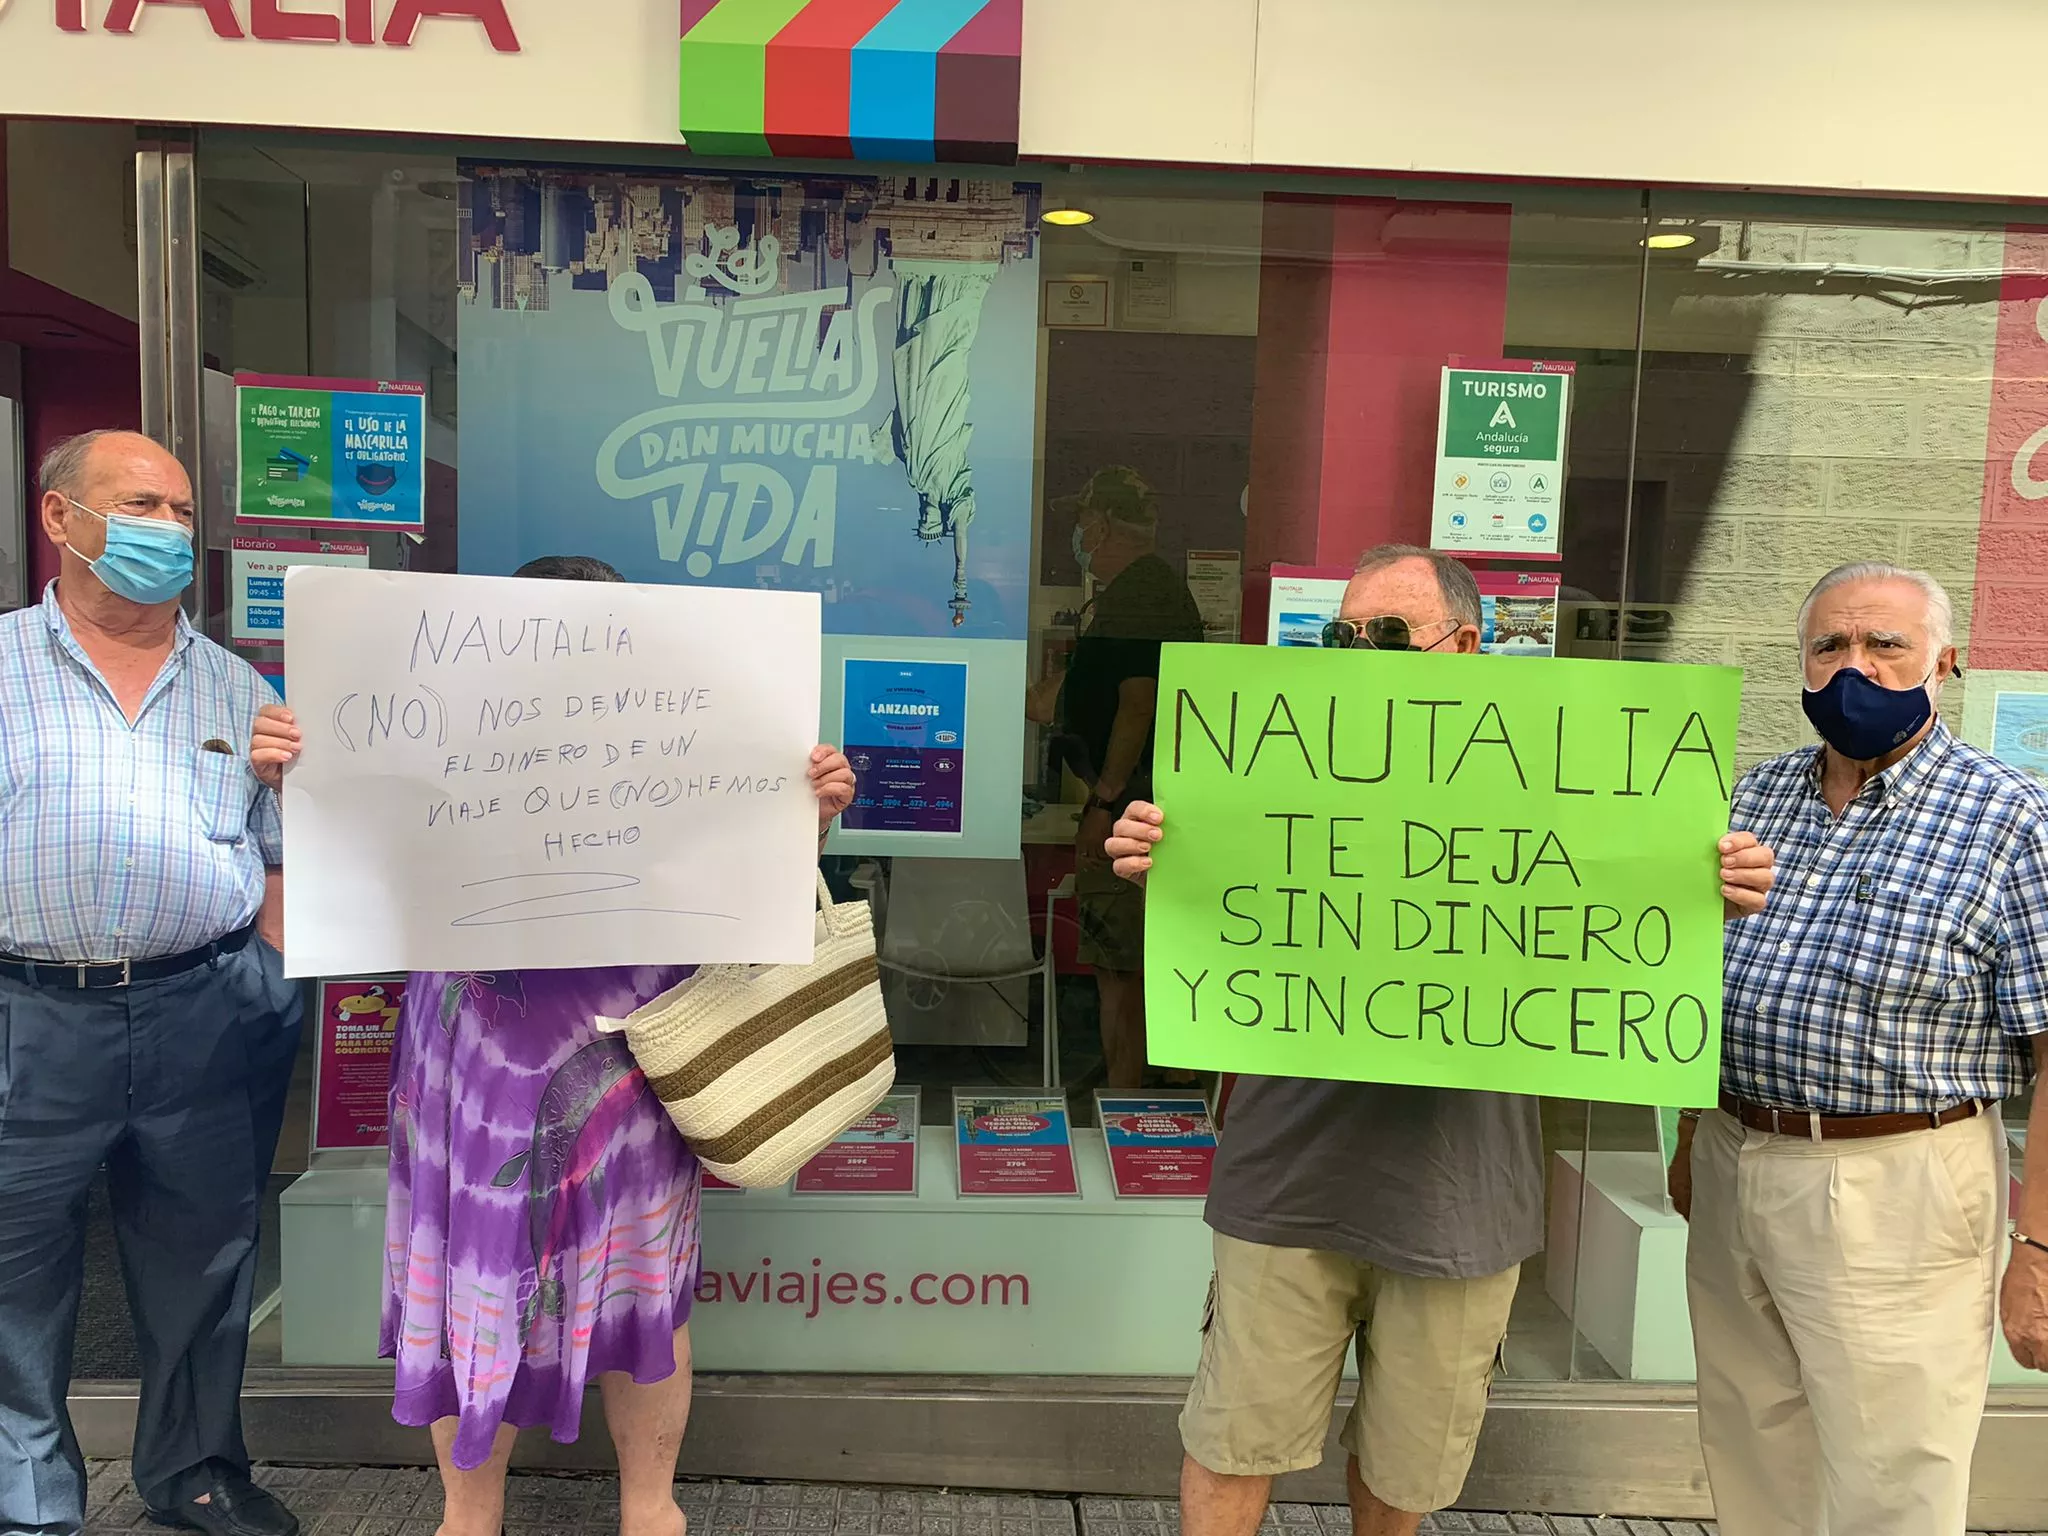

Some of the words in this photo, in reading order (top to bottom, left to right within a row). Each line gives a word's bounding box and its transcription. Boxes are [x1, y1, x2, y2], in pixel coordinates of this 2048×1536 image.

[685, 222, 780, 295] Las
[608, 270, 894, 402] VUELTAS
[1542, 363, 1575, 372] NAUTALIA
[388, 382, 423, 392] NAUTALIA
[1462, 380, 1547, 399] TURISMO
[258, 403, 278, 416] PAGO
[287, 405, 321, 419] TARJETA
[358, 416, 380, 433] USO
[395, 419, 407, 434] LA
[344, 433, 409, 450] MASCARILLA
[639, 425, 719, 469] DAN
[730, 423, 875, 466] MUCHA
[1475, 431, 1529, 443] Andalucía
[1483, 443, 1520, 455] segura
[235, 538, 277, 549] Horario
[330, 544, 365, 552] NAUTALIA
[247, 561, 265, 571] Ven
[276, 565, 288, 573] po
[249, 579, 271, 587] Lunes
[249, 588, 269, 597] 09:45
[249, 607, 281, 616] Sábados
[249, 617, 269, 626] 10:30
[332, 684, 448, 752] (NO)
[477, 696, 542, 736] NOS
[870, 703, 940, 716] LANZAROTE
[1174, 687, 1730, 801] NAUTALIA
[444, 750, 474, 778] EL
[482, 743, 588, 774] DINERO
[603, 739, 647, 768] DE
[660, 729, 698, 757] UN
[427, 796, 502, 827] VIAJE
[523, 786, 601, 814] QUE
[544, 826, 641, 861] HECHO
[1264, 812, 1364, 879] TE
[1401, 819, 1581, 887] DEJA
[1219, 883, 1363, 950] SIN
[1390, 898, 1671, 967] DINERO
[381, 1007, 400, 1031] 7
[1173, 967, 1208, 1023] Y
[1223, 968, 1347, 1036] SIN
[1364, 979, 1709, 1064] CRUCERO
[693, 1257, 1030, 1319] aviajes.com
